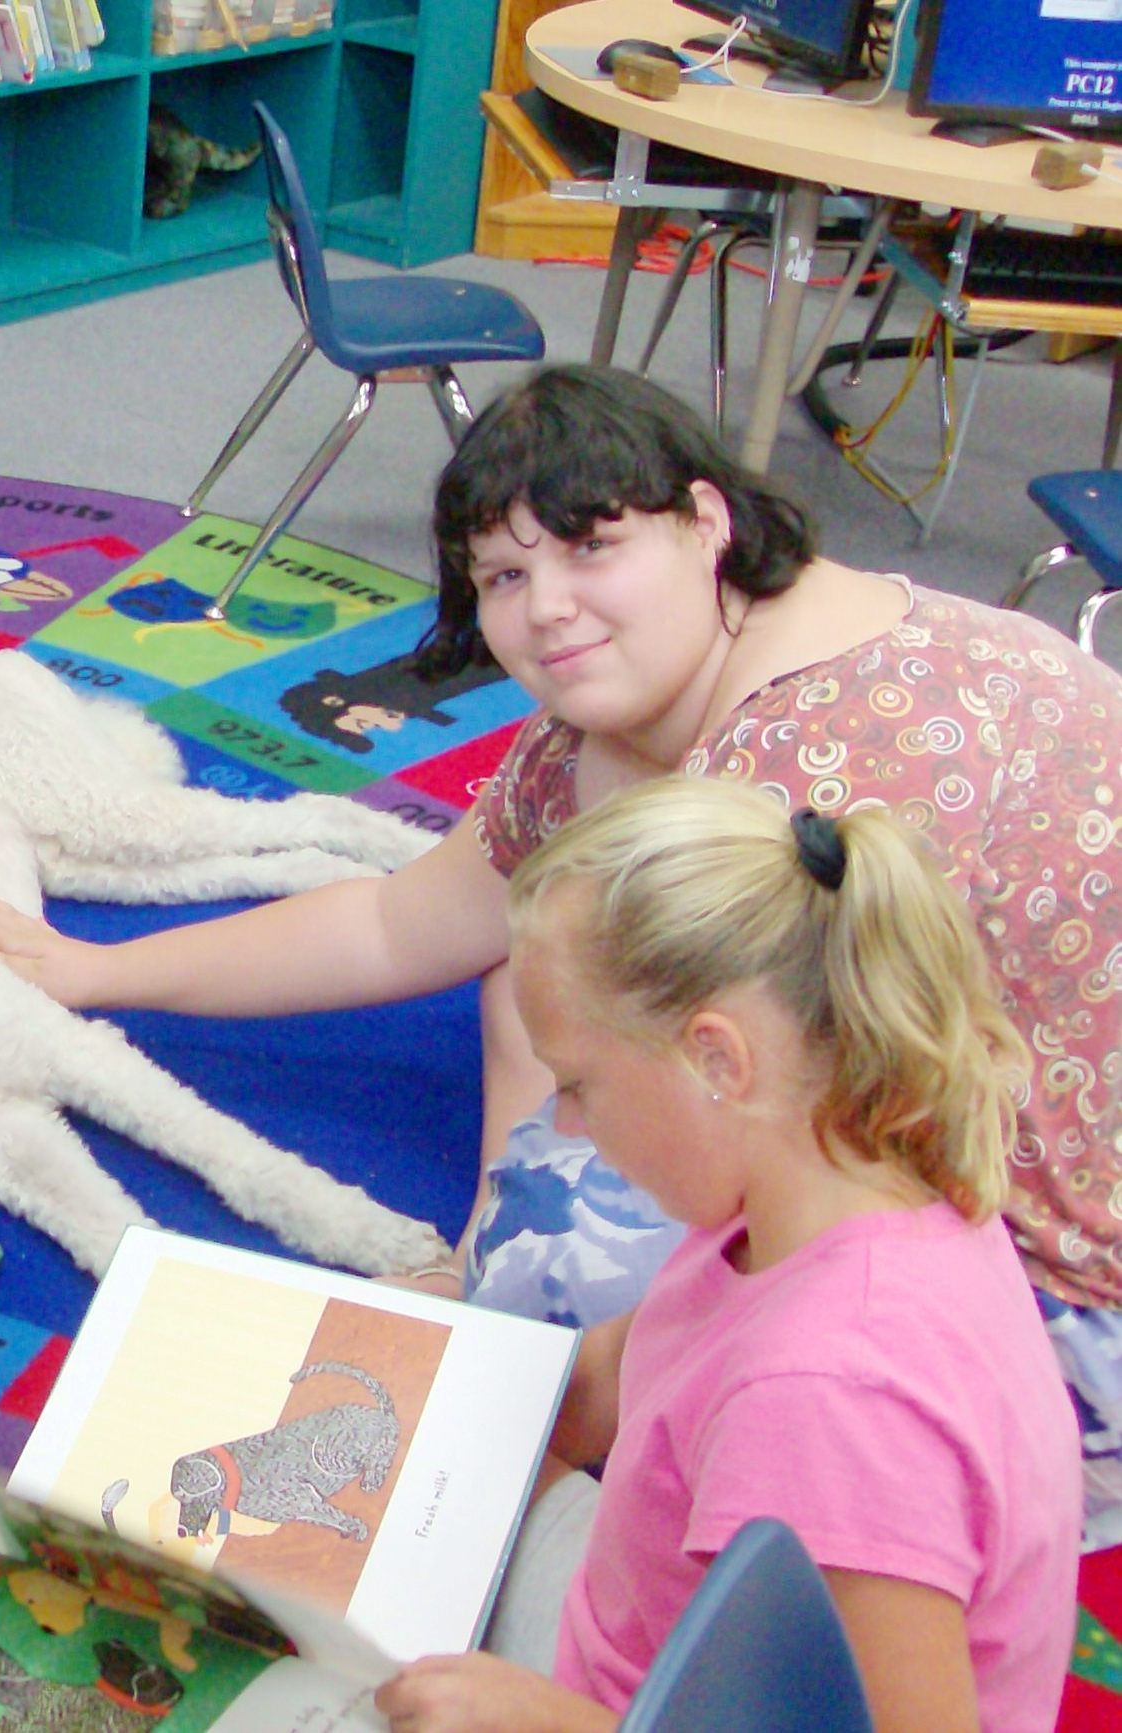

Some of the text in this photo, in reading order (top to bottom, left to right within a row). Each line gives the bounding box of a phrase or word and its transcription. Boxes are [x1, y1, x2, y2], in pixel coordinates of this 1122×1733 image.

[1066, 74, 1114, 95] PC12
[193, 533, 397, 604] Litrature
[209, 718, 320, 769] 973.7
[414, 1469, 451, 1539] Fresh milk!
